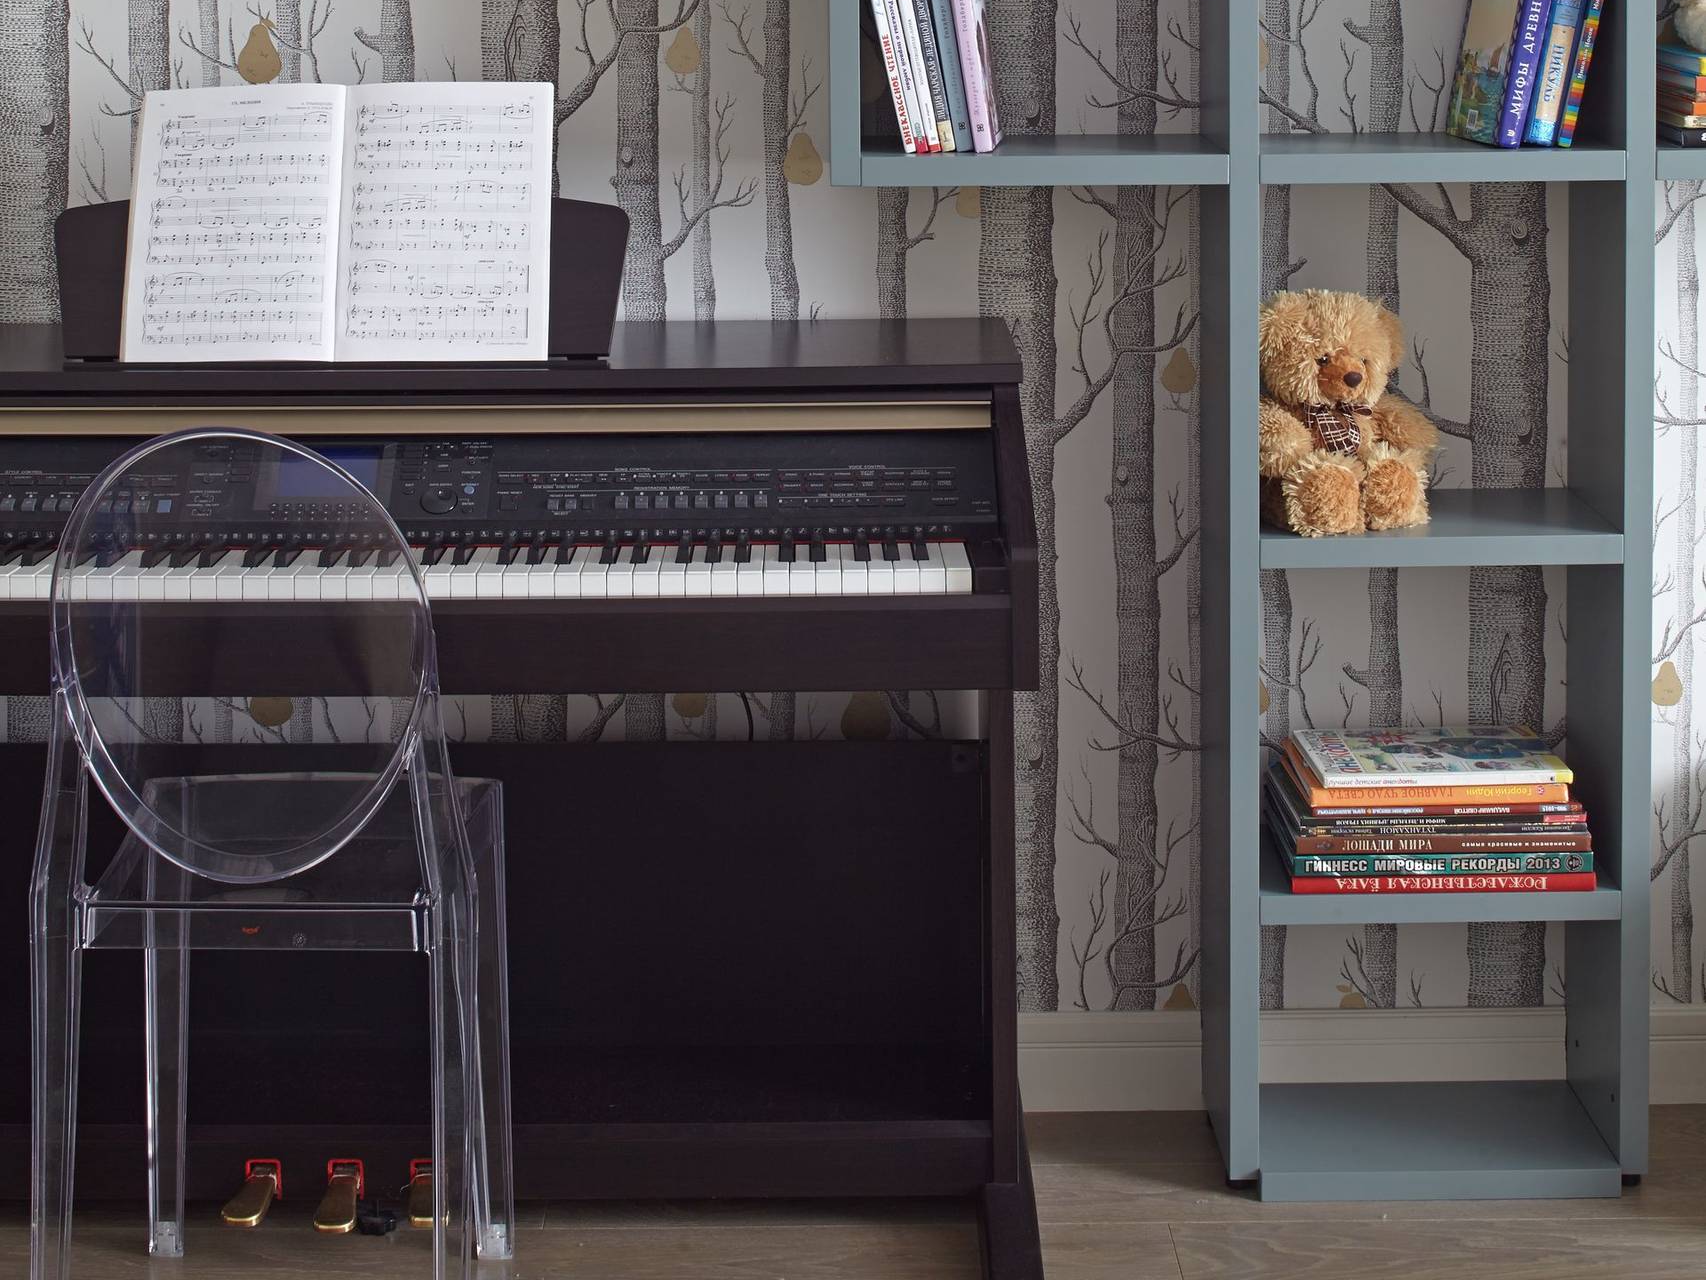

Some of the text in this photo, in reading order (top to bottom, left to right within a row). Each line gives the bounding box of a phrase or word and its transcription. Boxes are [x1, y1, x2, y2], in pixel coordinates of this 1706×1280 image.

[887, 0, 899, 33] Рассказы
[881, 33, 895, 72] ЧТЕНИЕ
[919, 21, 934, 57] ЛЕДЯНОЙ
[1576, 48, 1589, 79] Николай
[1583, 27, 1594, 47] Носов
[927, 59, 941, 94] ЧАРСКАЯ
[1510, 61, 1530, 115] МИФЫ
[890, 74, 913, 145] ВНЕКЛАССНОЕ
[934, 94, 947, 120] ЛИДИЯ
[1328, 787, 1452, 799] ГЛАВНОЕ ЧУДО СВЕТА
[1466, 786, 1532, 797] Георгий Юдин
[1342, 839, 1431, 851] ЛОШАДИ МИРА
[1305, 858, 1560, 872] ГИННЕСС МИРОВЫЕ РЕКОРДЫ 2013
[1335, 876, 1547, 892] РОЖДЕСТВЕНСКАЯ ЁЛКА
